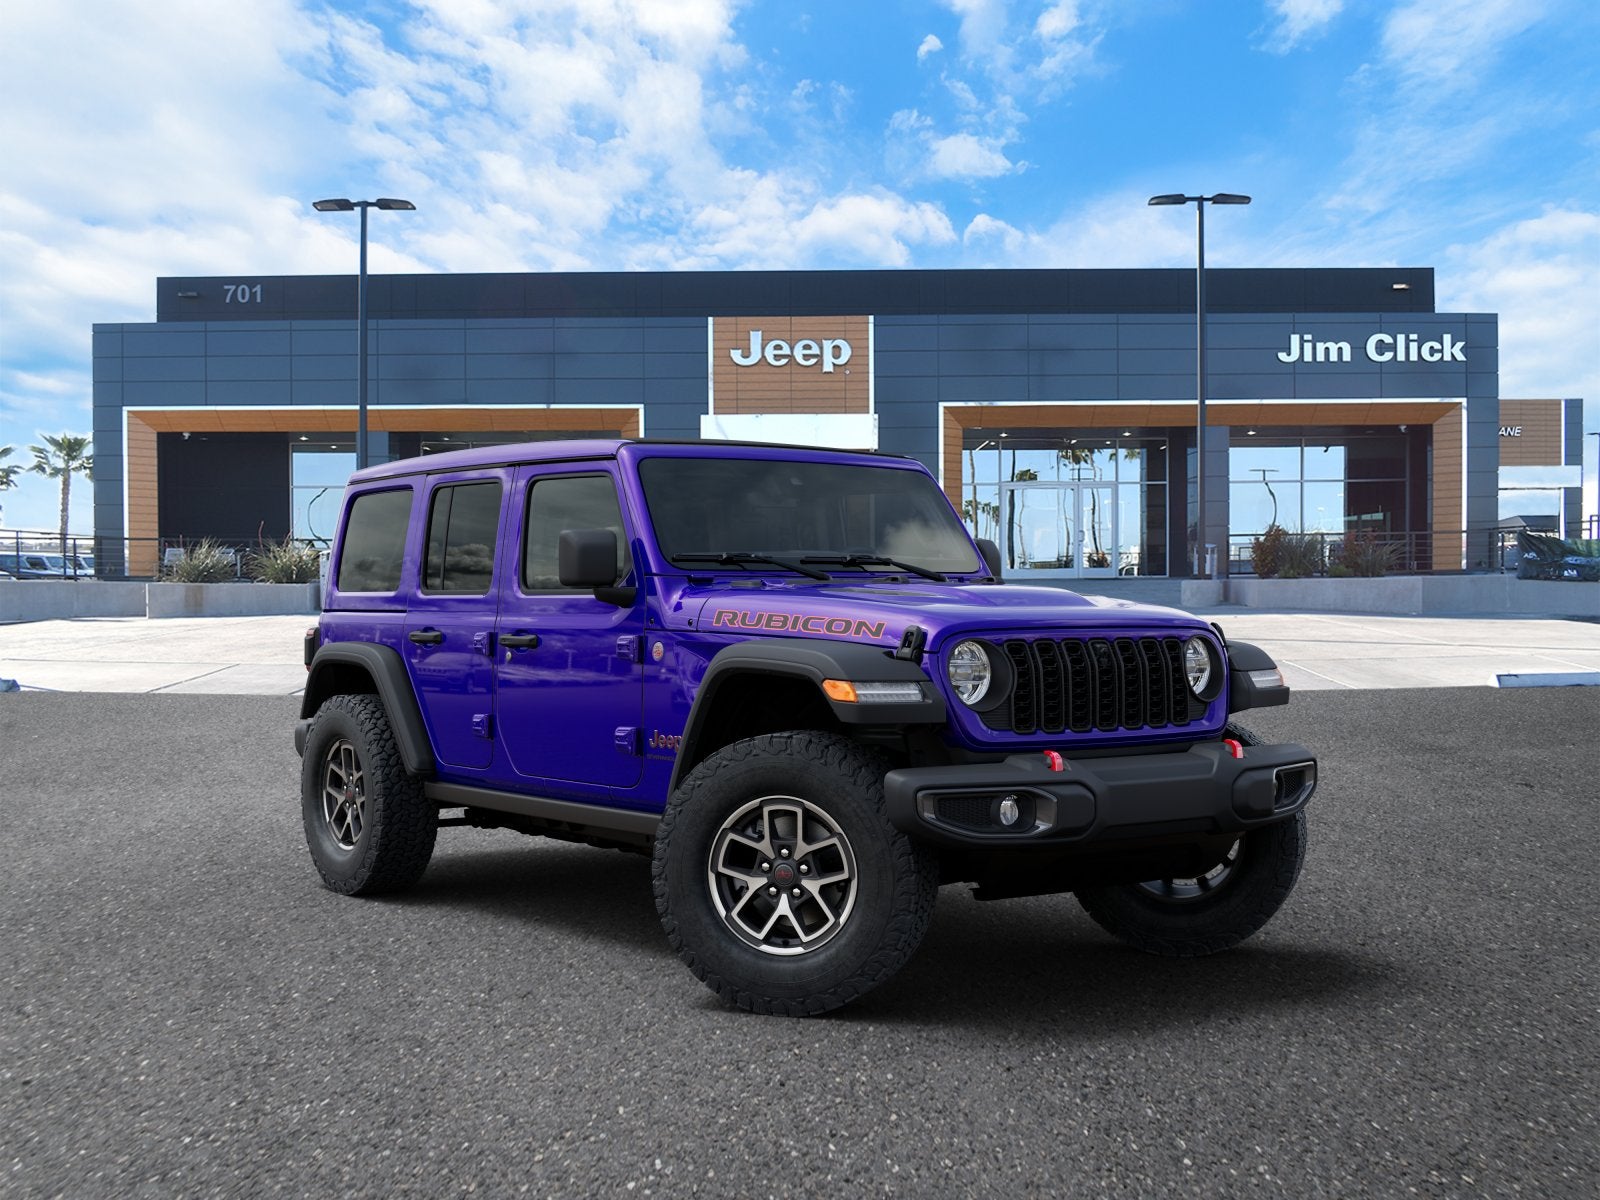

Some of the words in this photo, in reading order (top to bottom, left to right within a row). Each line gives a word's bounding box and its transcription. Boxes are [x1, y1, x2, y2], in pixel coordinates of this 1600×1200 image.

[223, 284, 262, 303] 701
[730, 330, 852, 373] Jeep
[1277, 333, 1351, 363] Jim
[1366, 333, 1467, 362] Click
[713, 609, 887, 639] RUBICON
